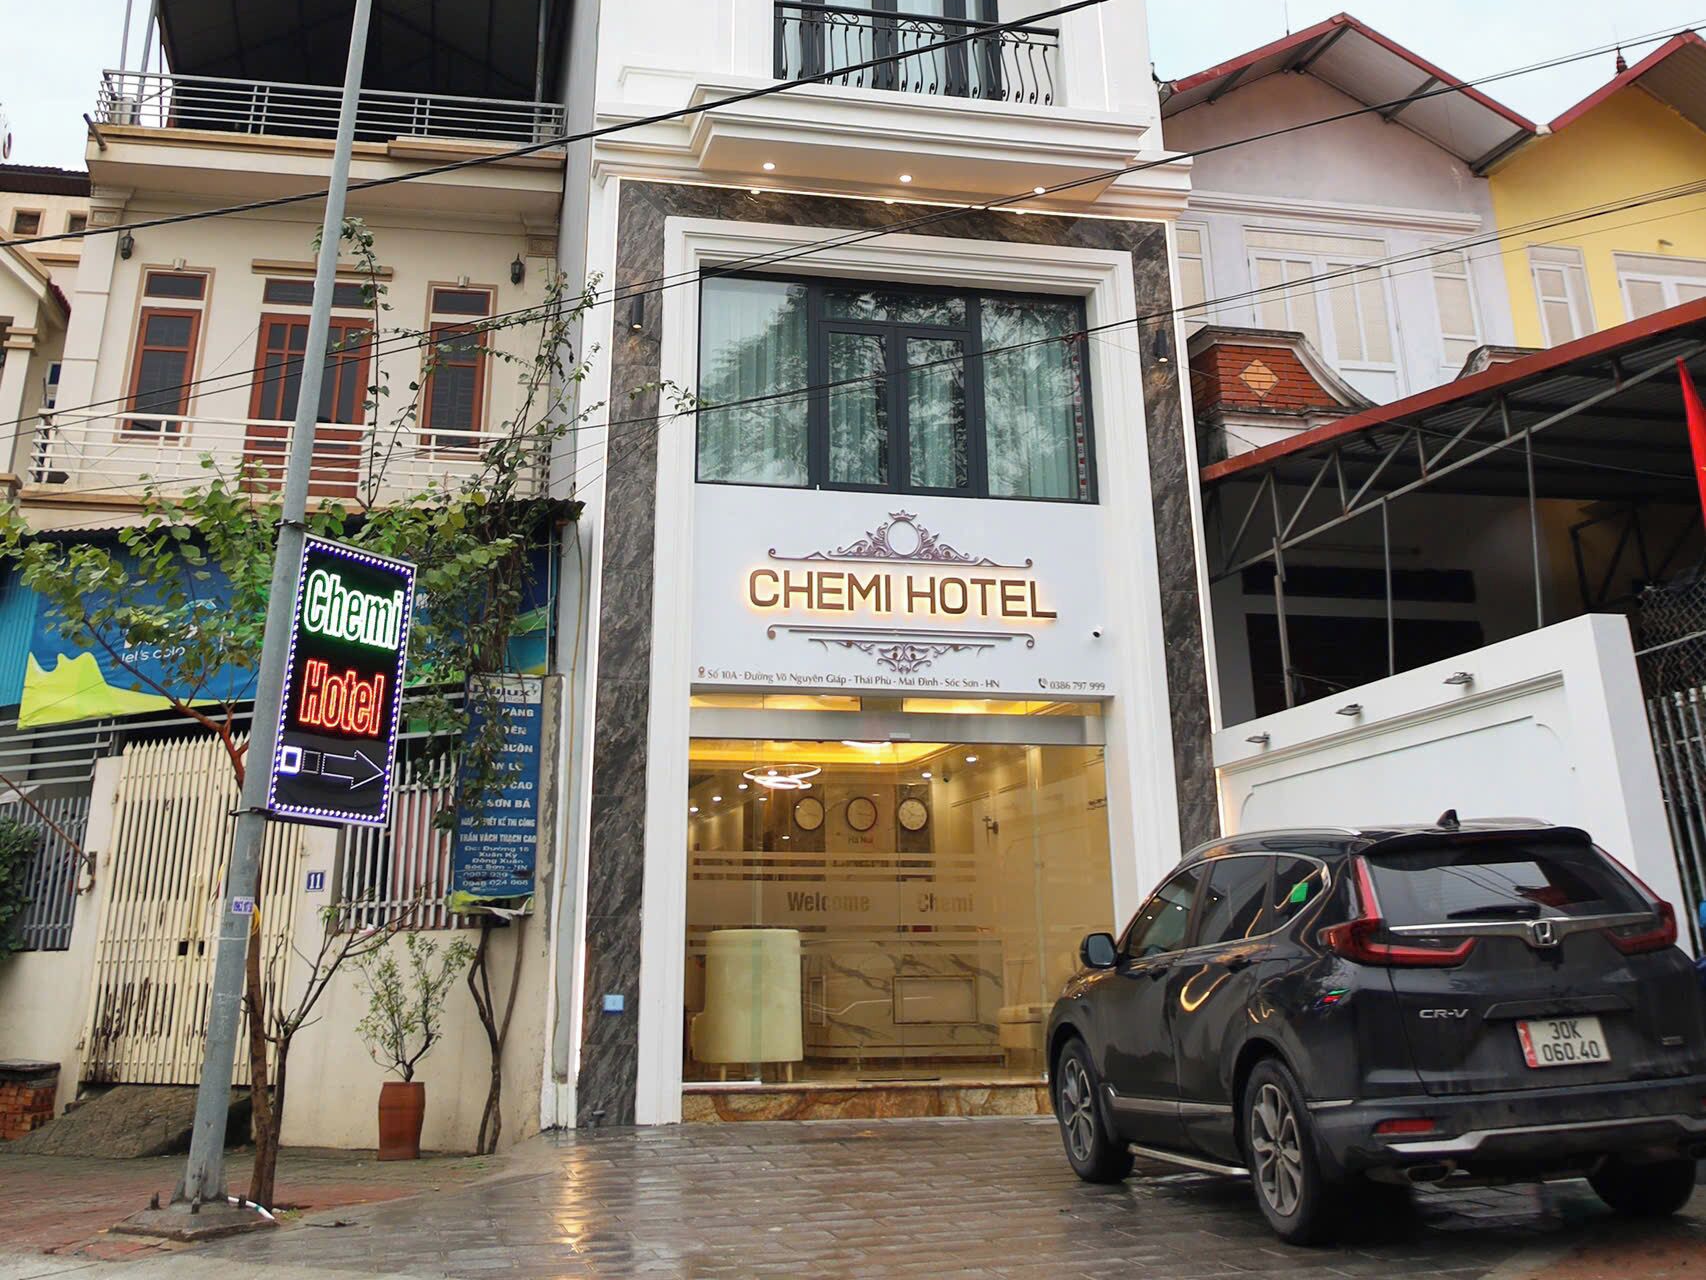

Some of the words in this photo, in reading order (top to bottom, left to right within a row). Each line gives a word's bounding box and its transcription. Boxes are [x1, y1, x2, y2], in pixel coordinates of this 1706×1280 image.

[749, 569, 891, 613] CHEMI
[906, 575, 1058, 619] HOTEL
[303, 569, 405, 651] Chemi
[721, 670, 738, 680] 10A
[743, 670, 774, 684] Đường
[789, 672, 824, 684] Nguyên
[825, 673, 847, 686] Giáp
[898, 677, 915, 686] Mai
[944, 677, 959, 688] Sóc
[985, 679, 1000, 689] HN
[1049, 680, 1071, 690] 0386
[1072, 681, 1087, 690] 797
[1088, 681, 1106, 691] 999
[299, 658, 385, 736] Hotel
[308, 873, 321, 889] 11
[786, 891, 871, 912] Welcome
[917, 892, 974, 912] Chemi
[1419, 1008, 1469, 1019] CR-V
[1549, 1020, 1583, 1041] 30K
[1541, 1040, 1601, 1062] 060.40
